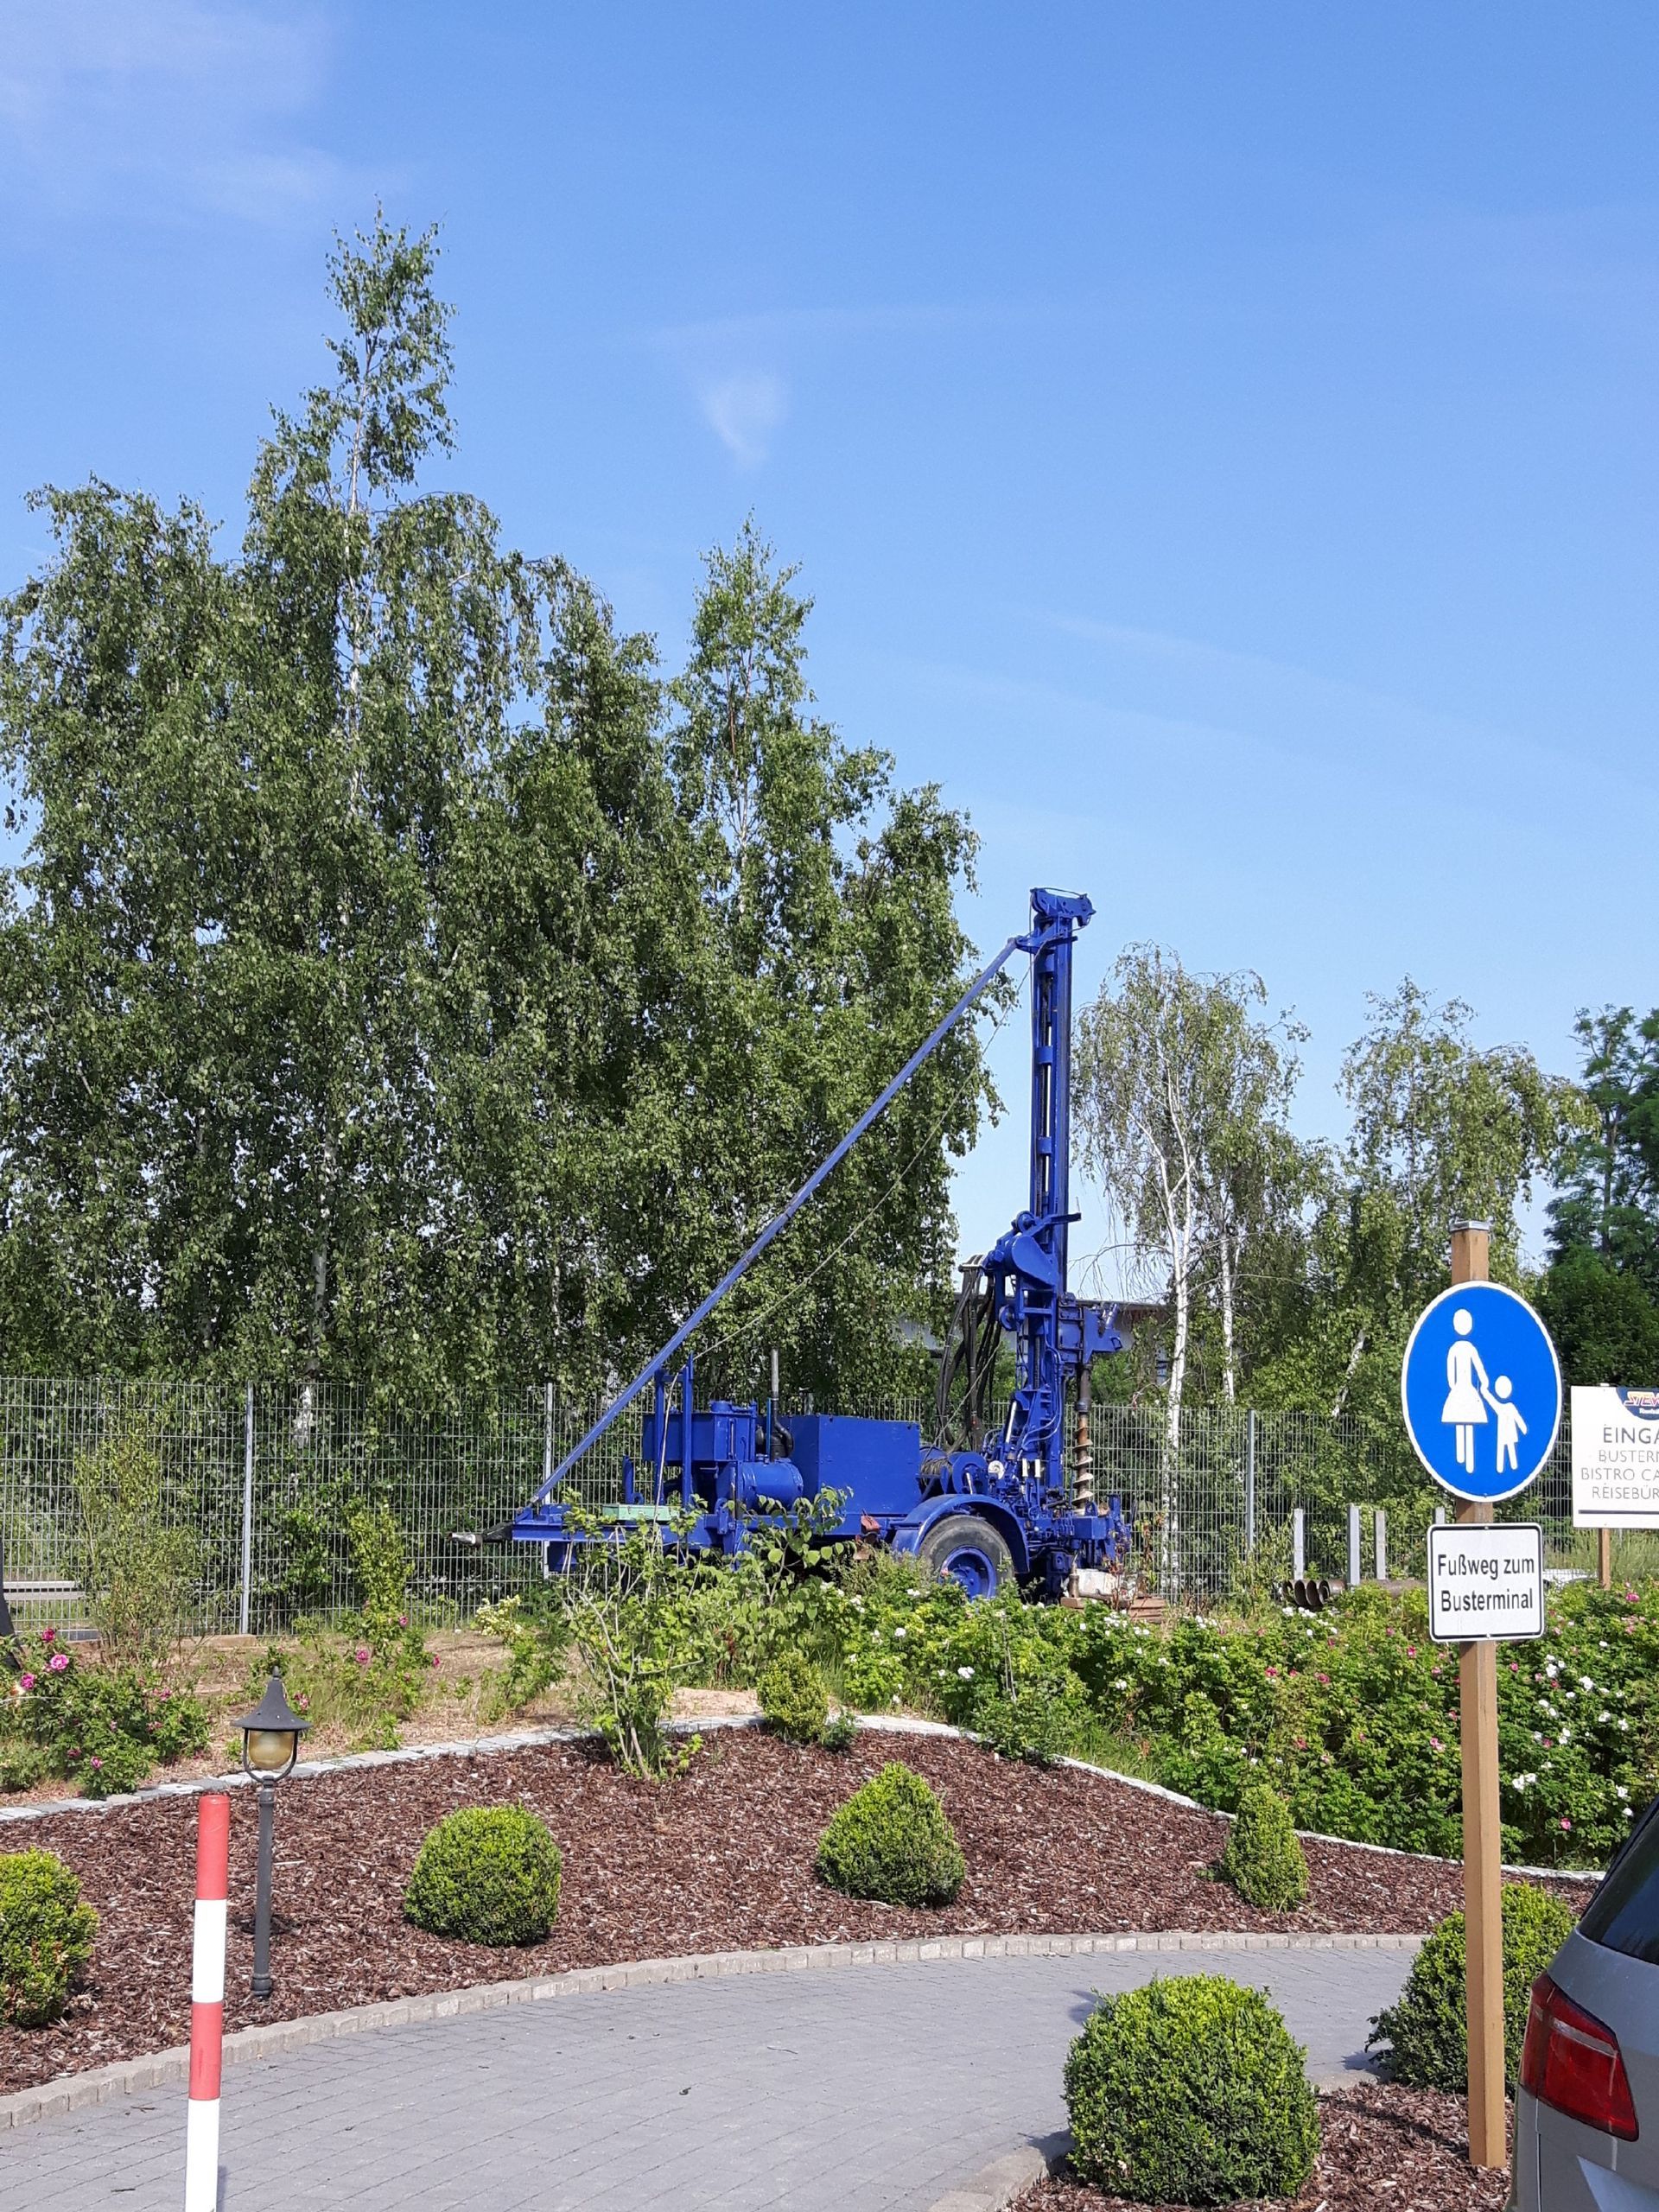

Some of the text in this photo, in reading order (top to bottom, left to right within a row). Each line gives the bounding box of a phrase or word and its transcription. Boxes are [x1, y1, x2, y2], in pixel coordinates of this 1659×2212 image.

[1581, 1467, 1635, 1481] BISTRO
[1438, 1554, 1535, 1580] Fußweg zum
[1441, 1587, 1533, 1612] Busterminal
